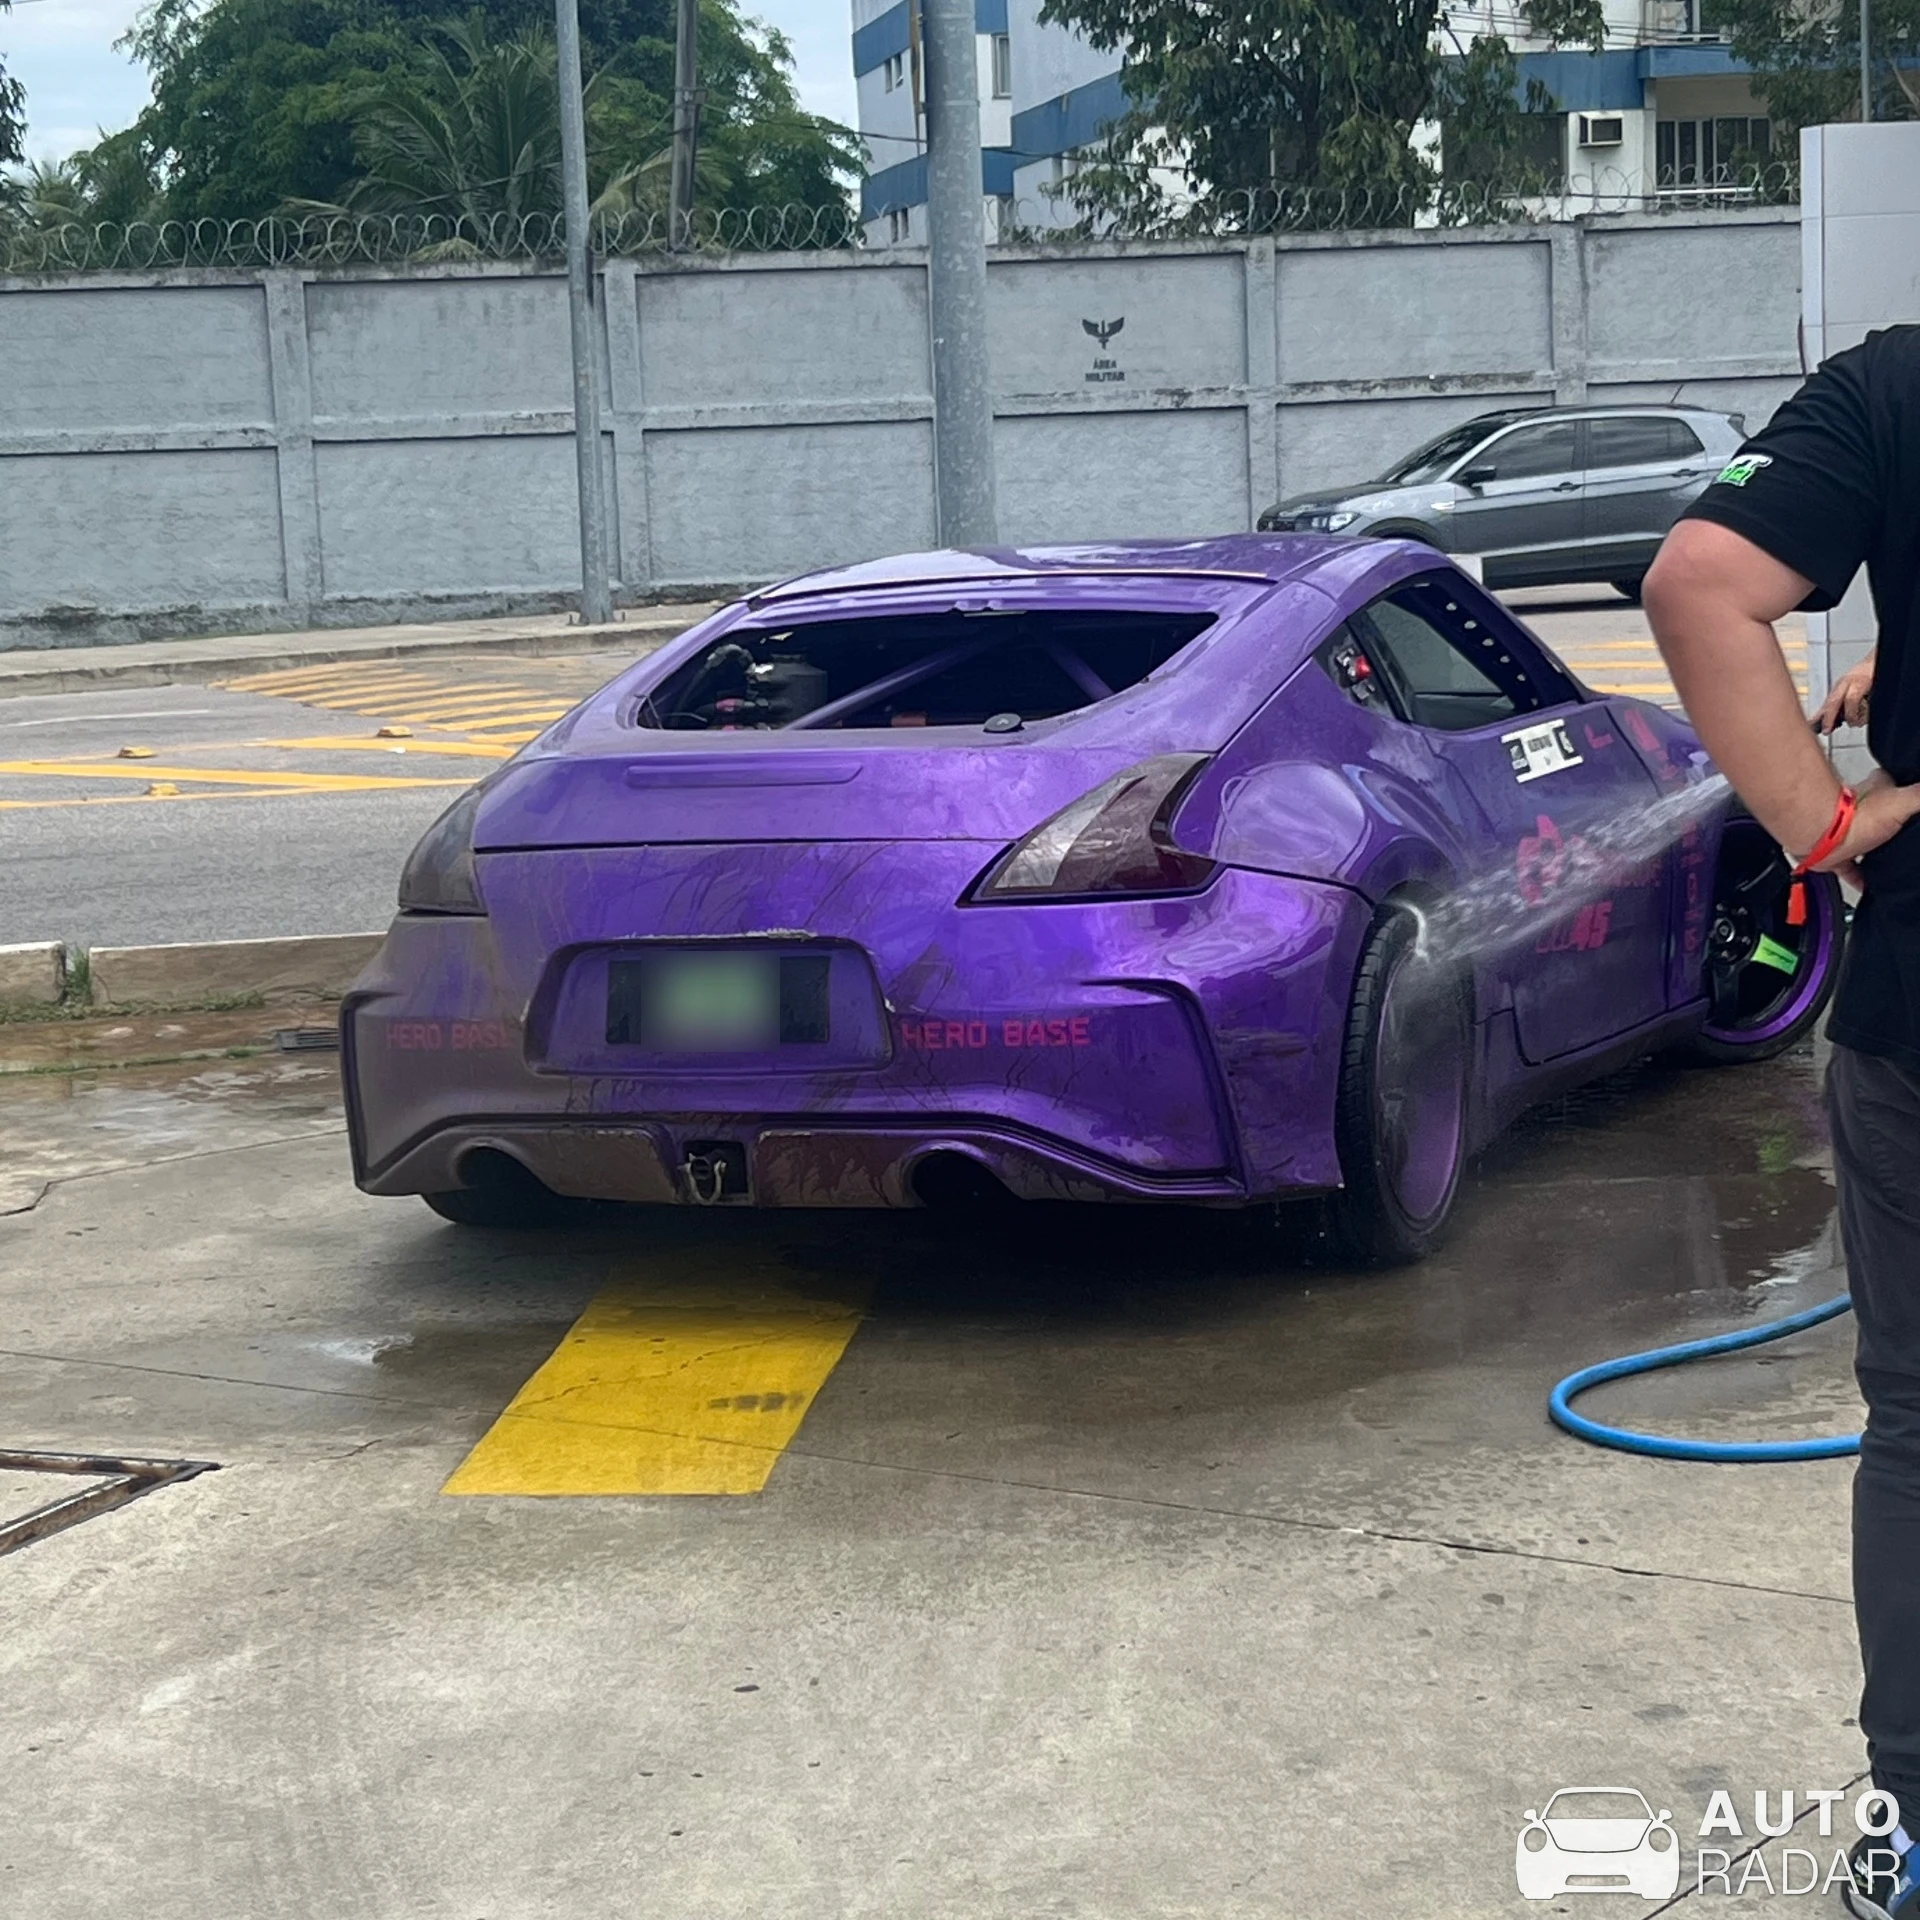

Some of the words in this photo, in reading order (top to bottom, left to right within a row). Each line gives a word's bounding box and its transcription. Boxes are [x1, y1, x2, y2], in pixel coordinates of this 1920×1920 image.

[1084, 371, 1125, 382] MILITAR
[386, 1022, 443, 1050] HERO
[902, 1020, 989, 1049] HERO
[1003, 1017, 1090, 1047] BASE
